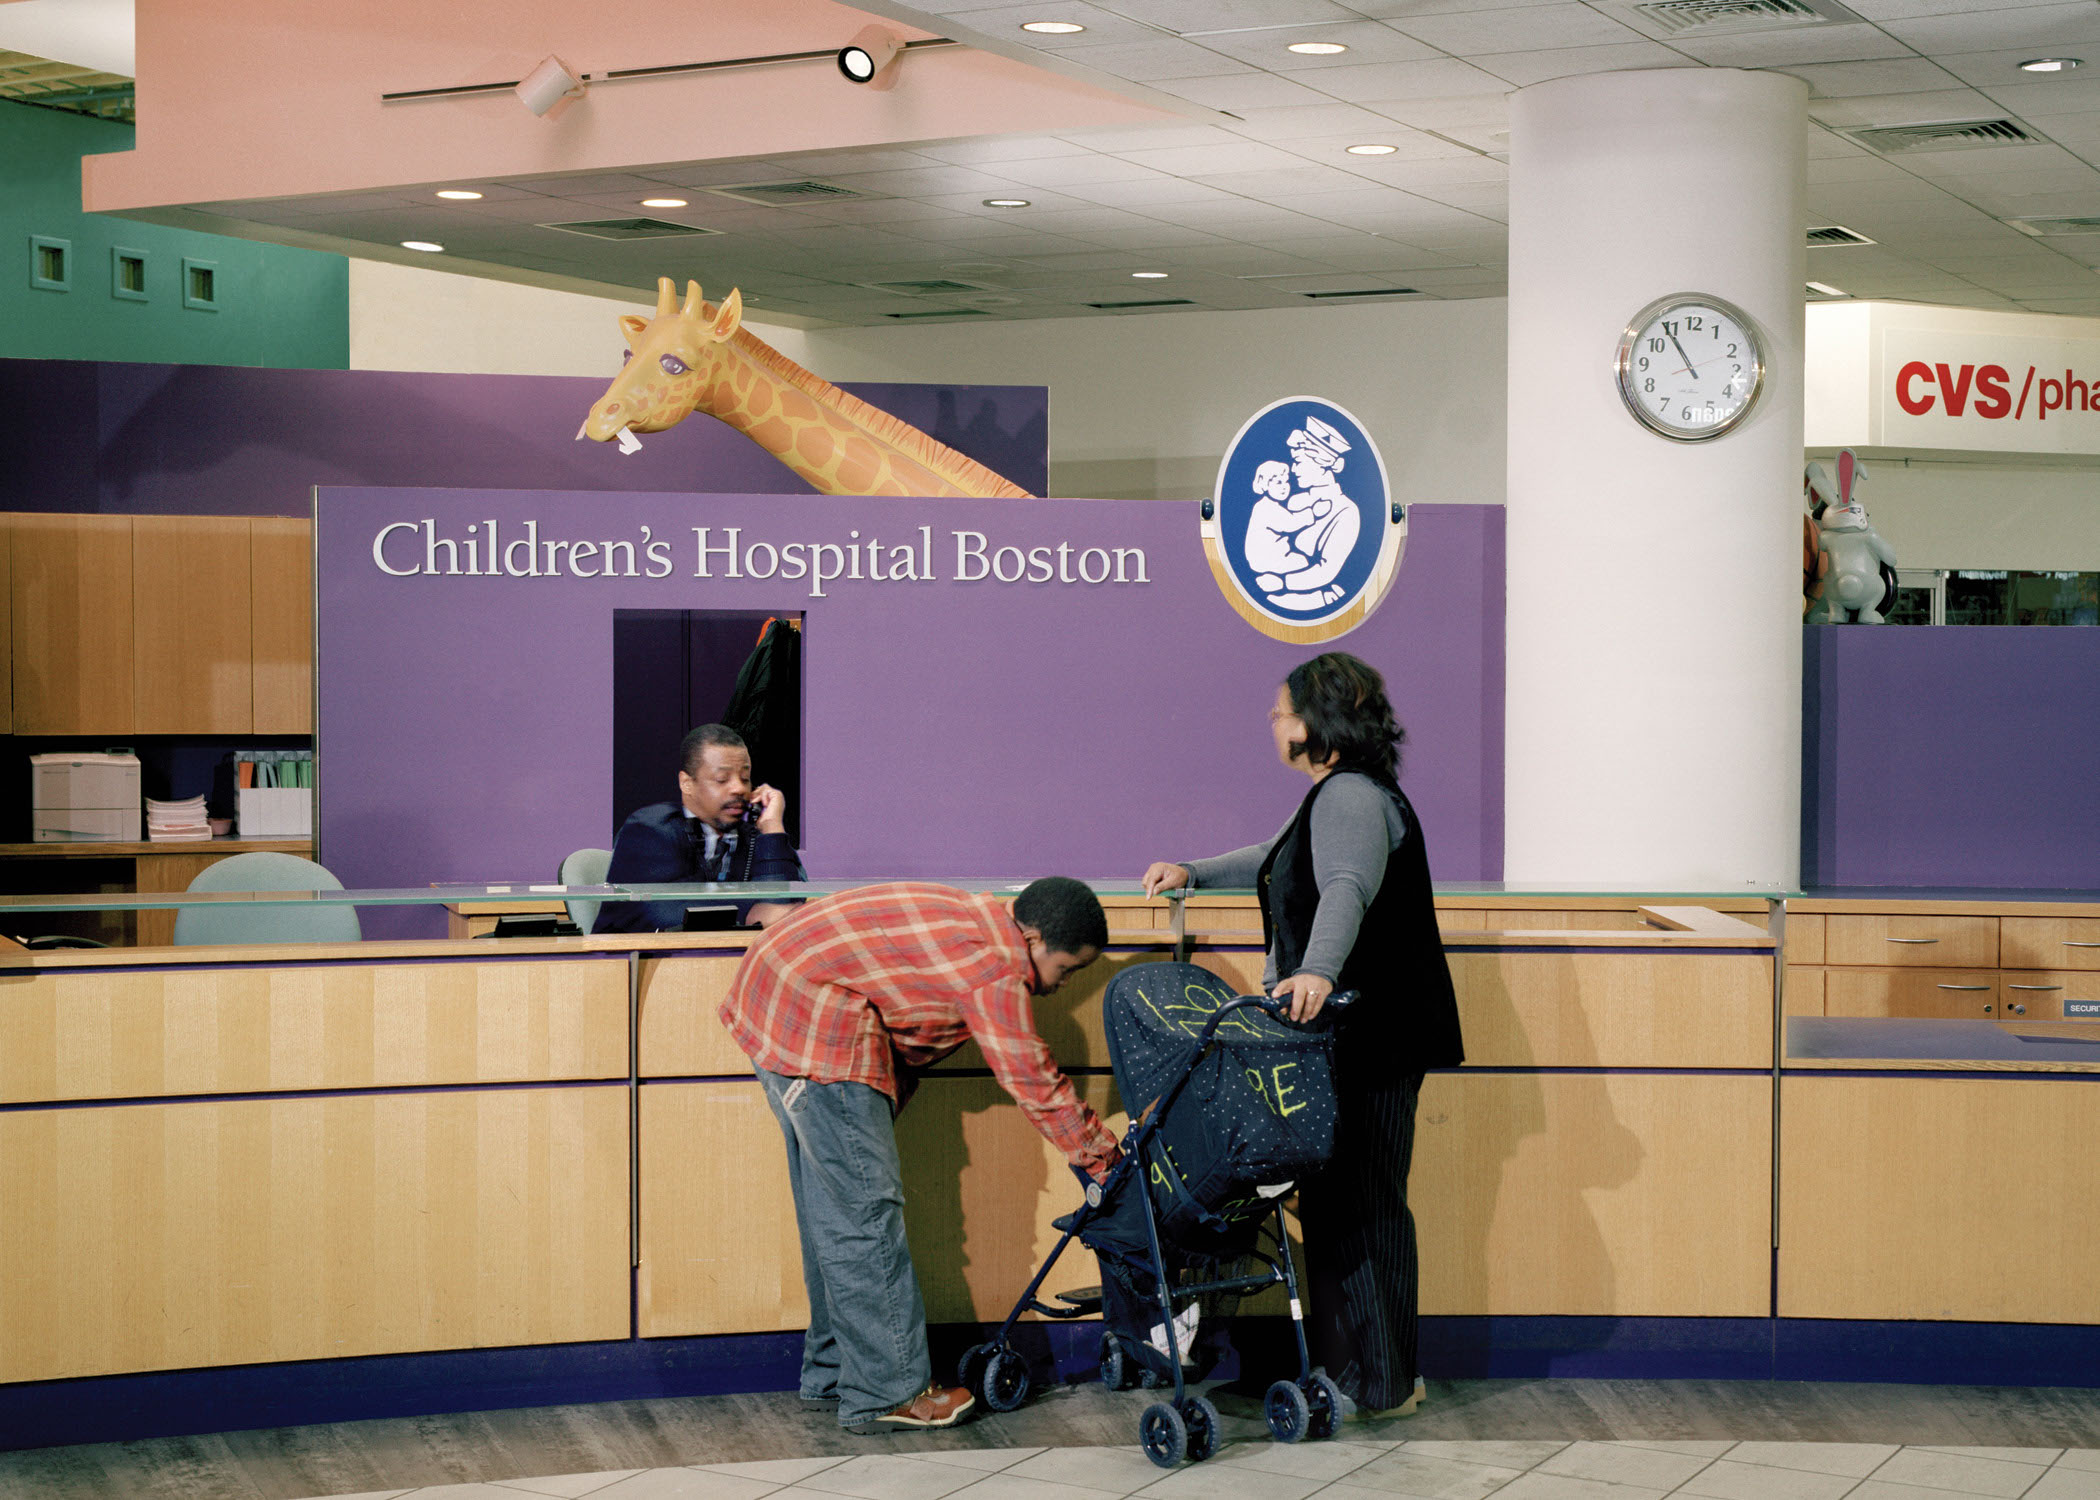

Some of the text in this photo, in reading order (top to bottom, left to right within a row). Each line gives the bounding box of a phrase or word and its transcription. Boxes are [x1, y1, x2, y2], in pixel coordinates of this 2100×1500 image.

[1664, 321, 1678, 336] 11
[1685, 316, 1702, 331] 12
[1711, 325, 1719, 339] 1
[1647, 338, 1665, 353] 10
[1727, 344, 1737, 358] 2
[1639, 357, 1649, 372] 9
[1645, 378, 1655, 392] 8
[1722, 384, 1732, 398] 4
[1660, 397, 1670, 412] 7
[1706, 401, 1714, 415] 5
[1682, 405, 1691, 420] 6
[372, 518, 1151, 597] Children’s Hospital Boston
